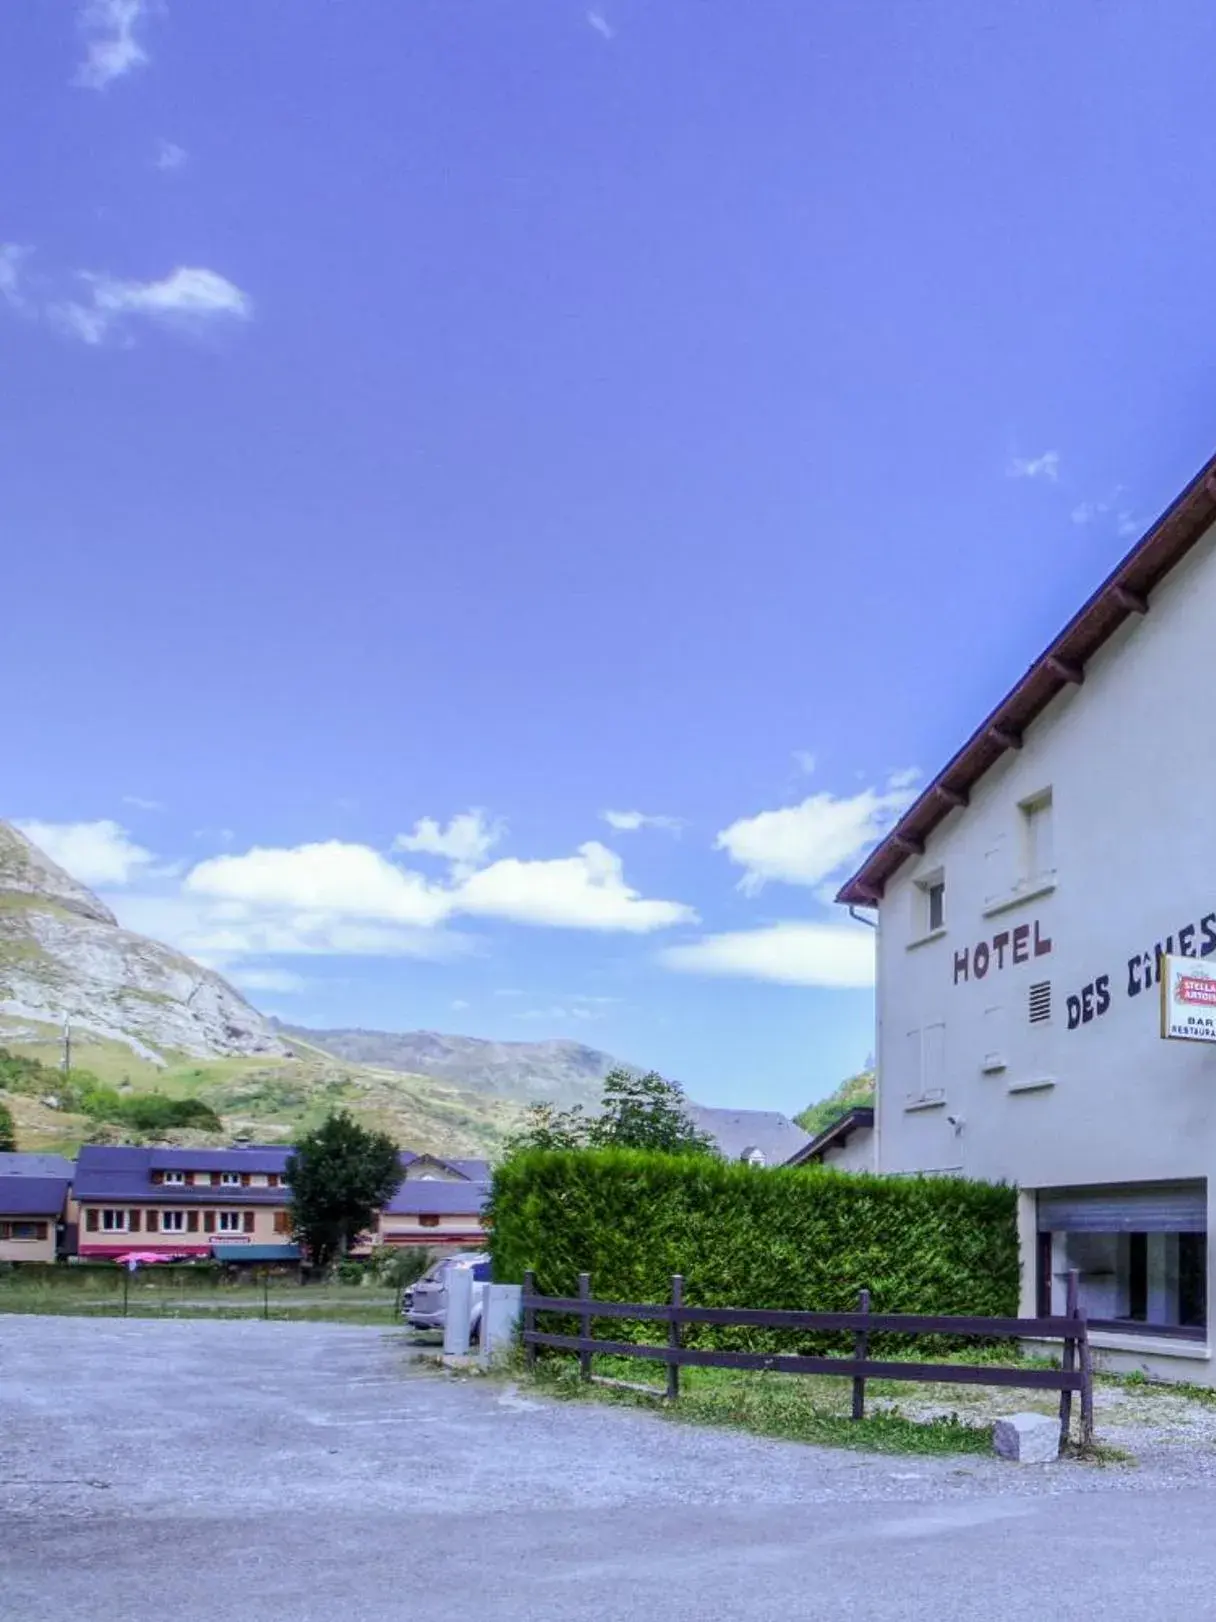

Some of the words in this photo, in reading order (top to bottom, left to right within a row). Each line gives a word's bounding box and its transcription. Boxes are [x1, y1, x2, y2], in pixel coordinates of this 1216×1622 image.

[954, 920, 1052, 985] HOTEL
[1067, 975, 1110, 1030] DES
[1183, 981, 1216, 992] STELLA
[1187, 1016, 1213, 1027] BAR
